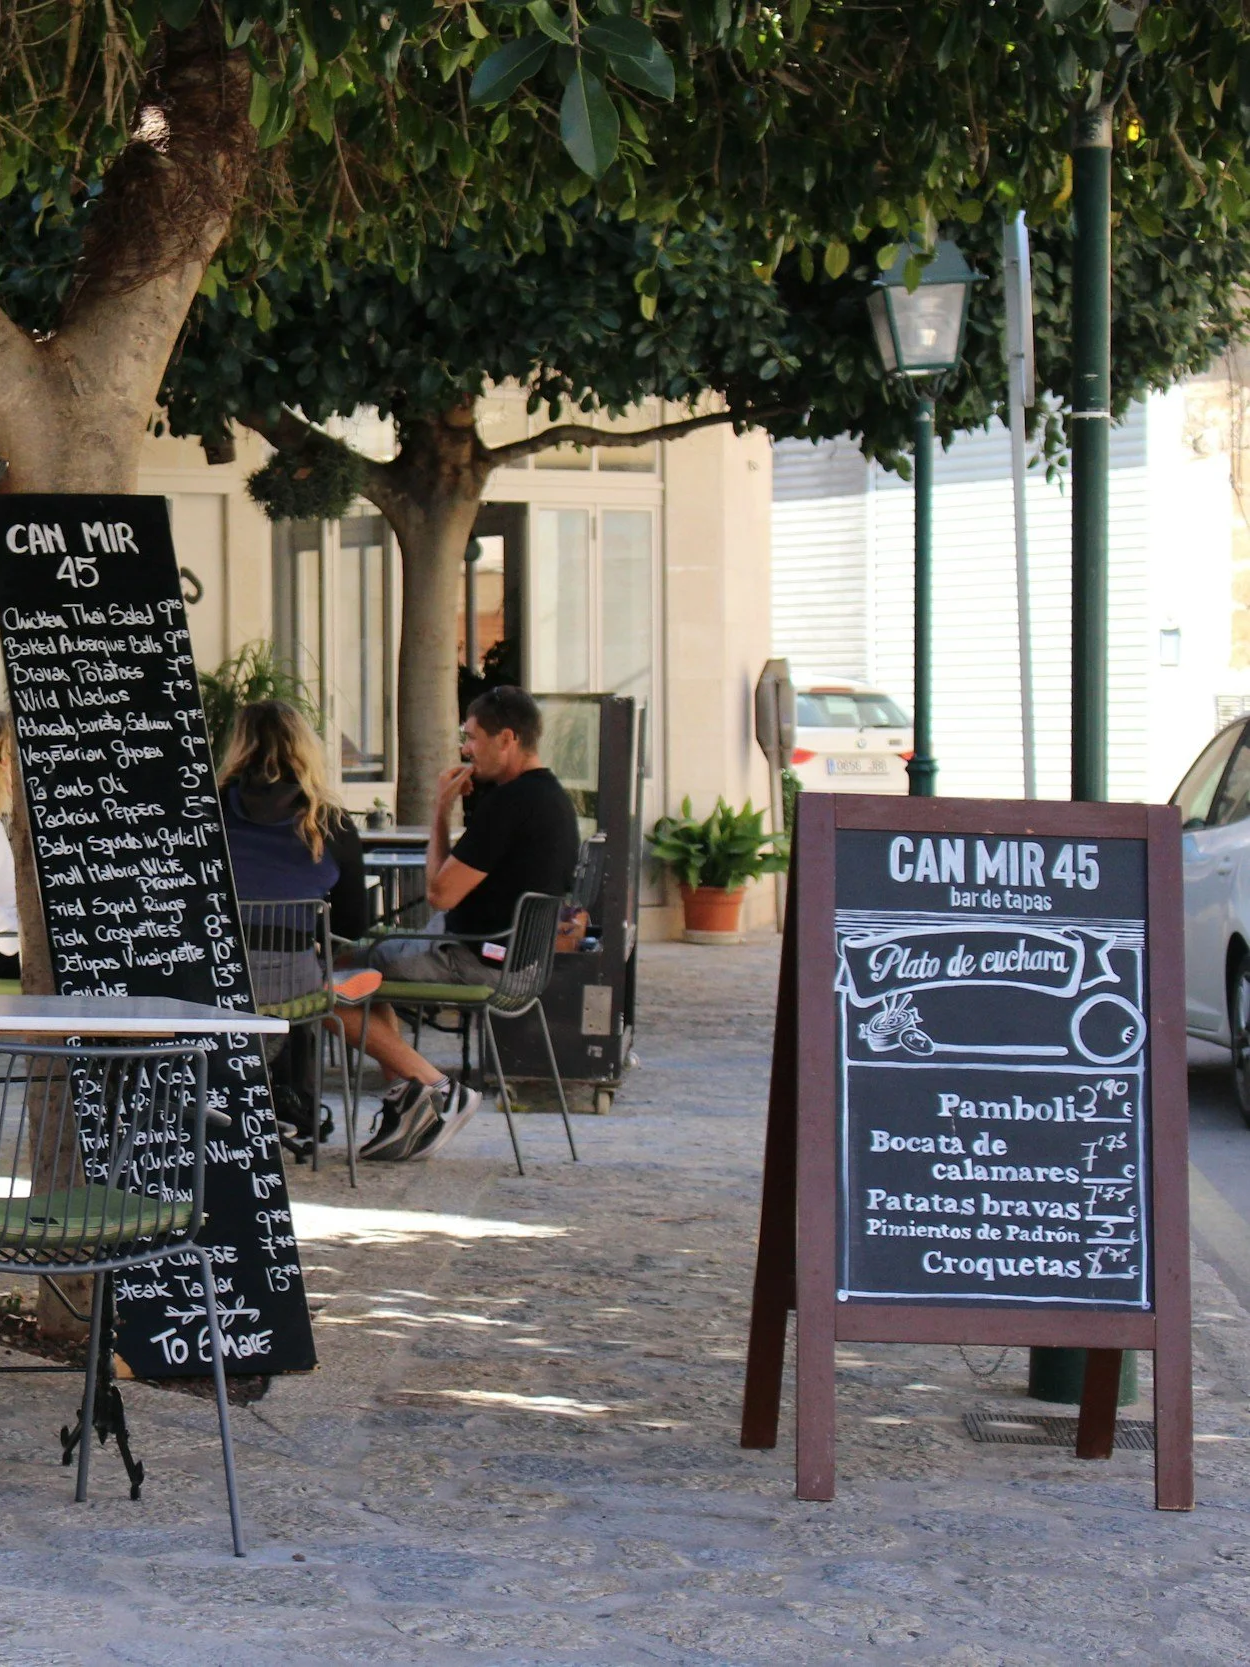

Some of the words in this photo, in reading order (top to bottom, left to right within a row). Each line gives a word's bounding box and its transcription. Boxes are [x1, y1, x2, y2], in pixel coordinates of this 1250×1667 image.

[6, 522, 67, 555] CAN
[81, 521, 140, 554] MIR
[56, 556, 100, 588] 45
[62, 603, 107, 625] Thai
[108, 603, 155, 626] Salad
[128, 635, 163, 655] Balls
[14, 687, 61, 713] Wild
[67, 685, 131, 708] Nachos
[27, 776, 48, 801] Pa
[54, 776, 94, 800] amb
[97, 772, 129, 795] Oli
[37, 834, 86, 865] Baby
[889, 835, 965, 884] CAN
[976, 839, 1046, 888] MIR
[1051, 844, 1101, 891] 45
[141, 896, 187, 924] Rings
[950, 885, 977, 908] bar
[981, 889, 1002, 909] de
[1005, 889, 1053, 914] tapas
[51, 927, 89, 949] Fish
[868, 942, 941, 983] Plato
[946, 944, 977, 975] de
[980, 938, 1071, 974] cuchara
[937, 1093, 1078, 1123] Pamboli
[206, 1139, 254, 1172] Wings
[870, 1129, 966, 1156] Bocata
[972, 1132, 1008, 1156] de
[932, 1158, 1080, 1184] calamares
[866, 1188, 976, 1216] Patatas
[981, 1192, 1082, 1221] bravas
[866, 1218, 972, 1240] Pimientos
[976, 1222, 1002, 1240] de
[1006, 1225, 1081, 1243] Padrón
[923, 1250, 1082, 1281] Croquetas
[150, 1327, 190, 1365] To
